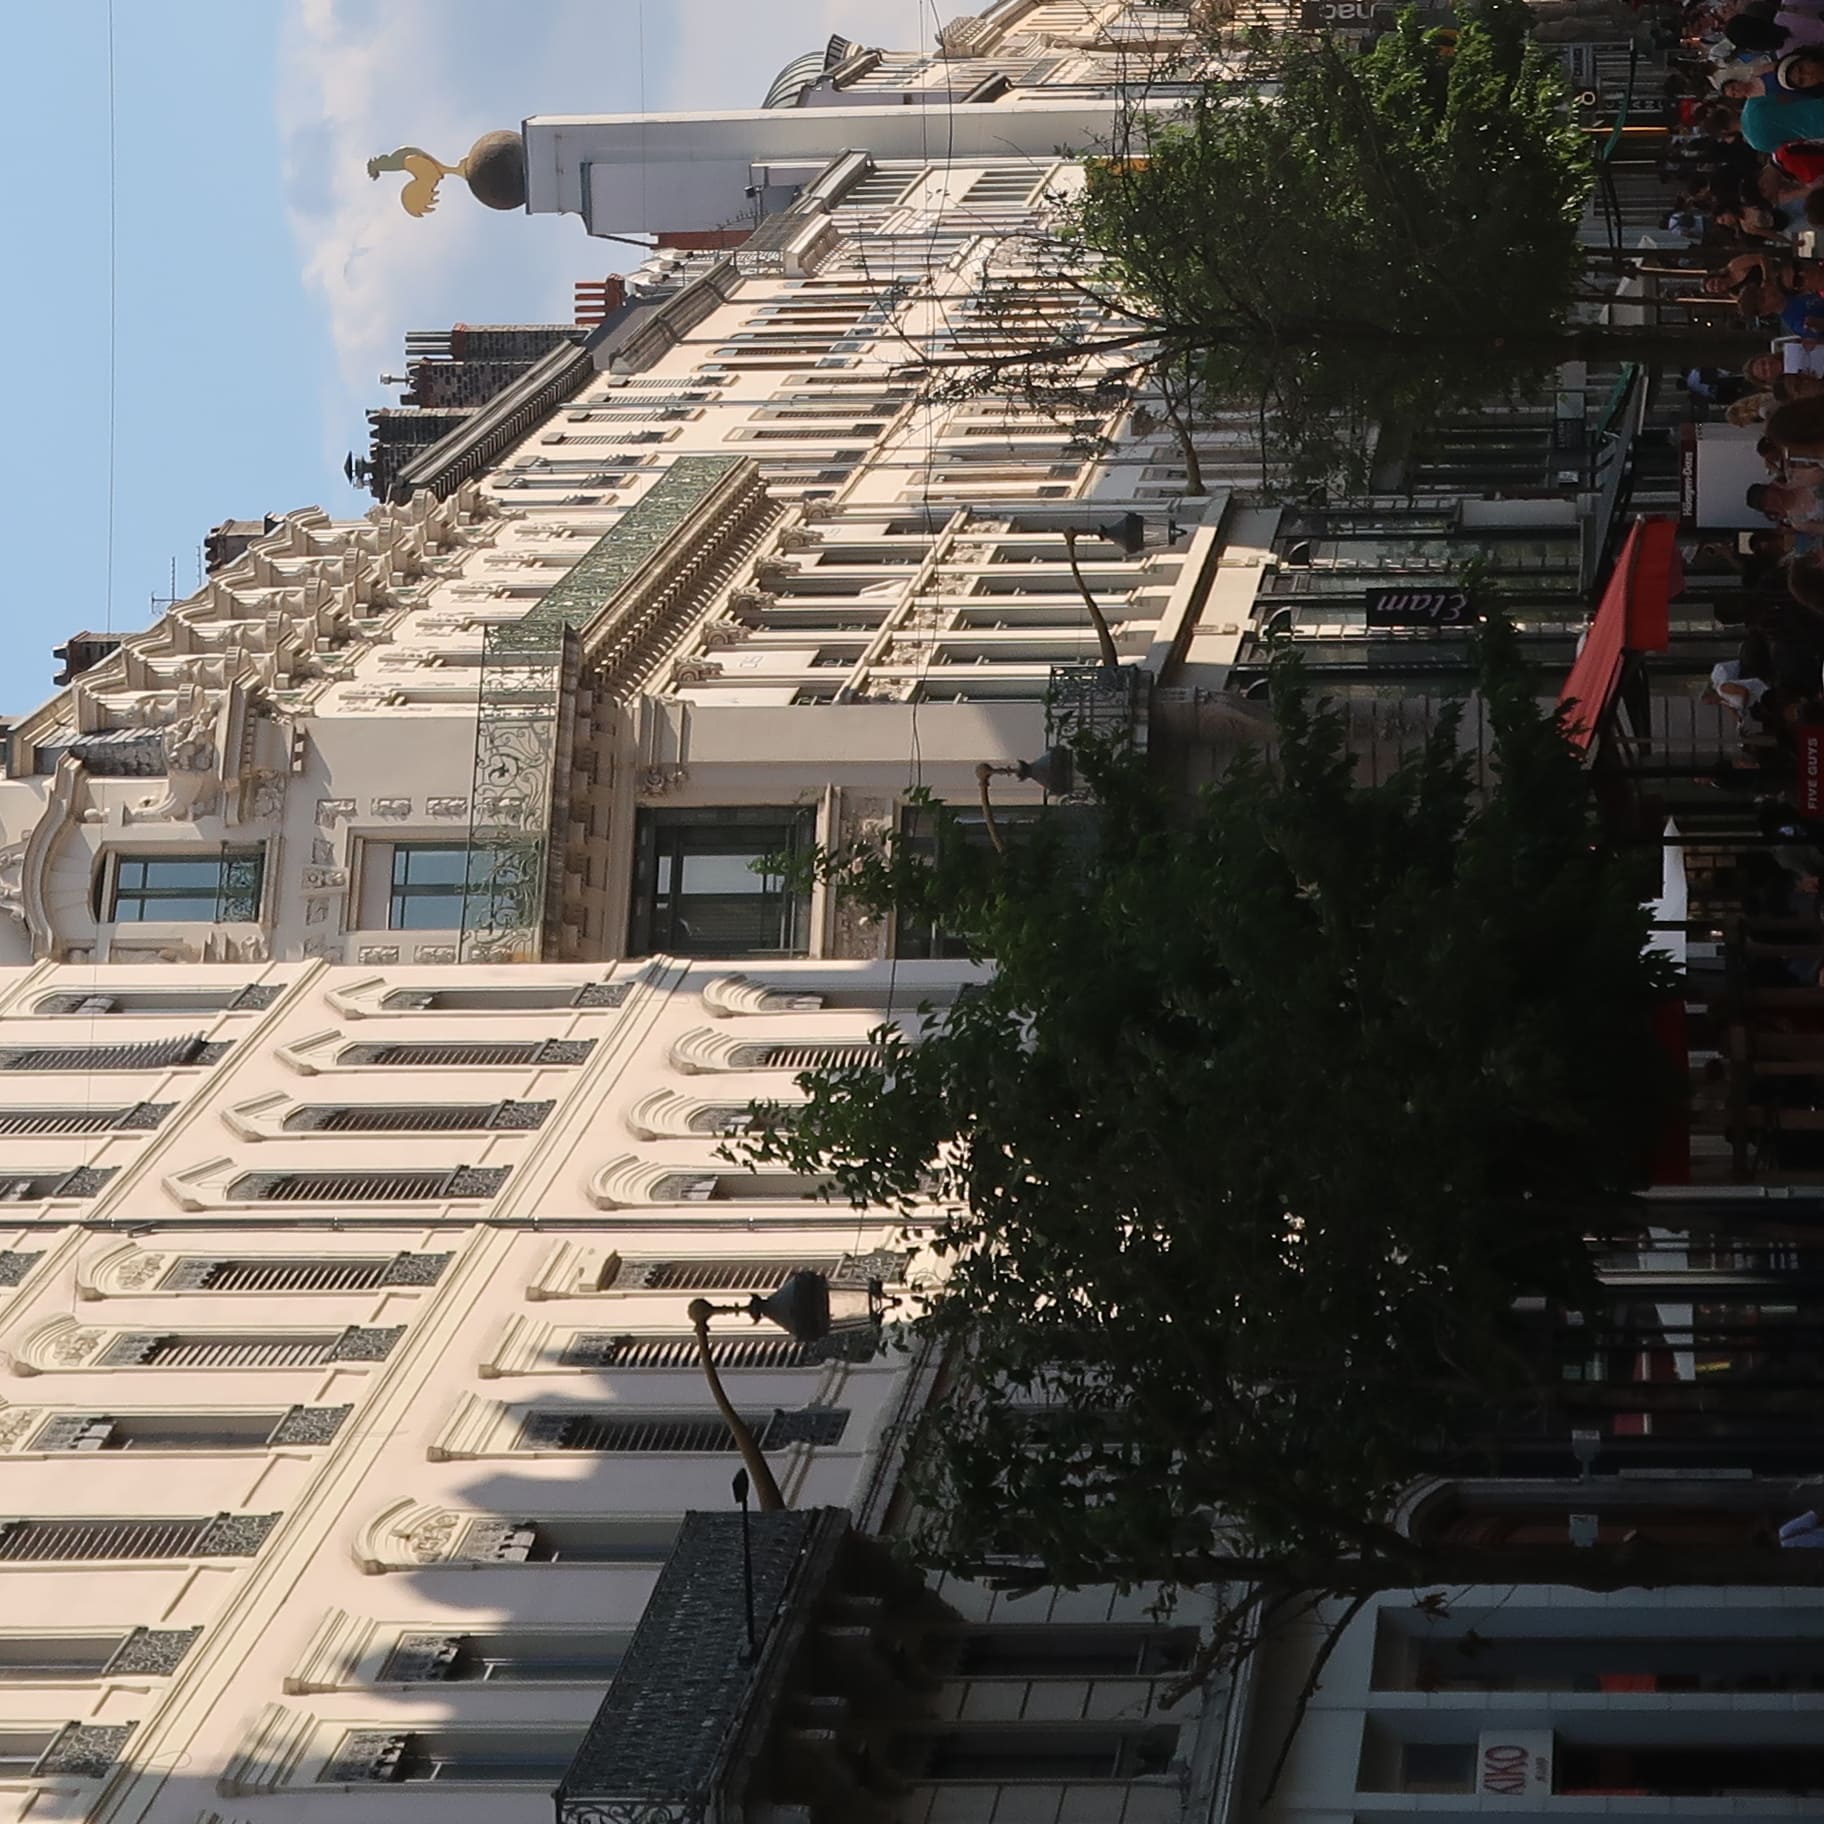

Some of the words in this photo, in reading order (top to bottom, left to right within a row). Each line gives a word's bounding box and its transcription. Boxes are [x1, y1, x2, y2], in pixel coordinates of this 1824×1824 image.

[1681, 451, 1694, 517] Häagen-Dazs
[1376, 593, 1468, 621] Etam
[1807, 737, 1818, 776] GUYS
[1807, 779, 1818, 810] FIVE
[1483, 1745, 1528, 1795] KIKO
